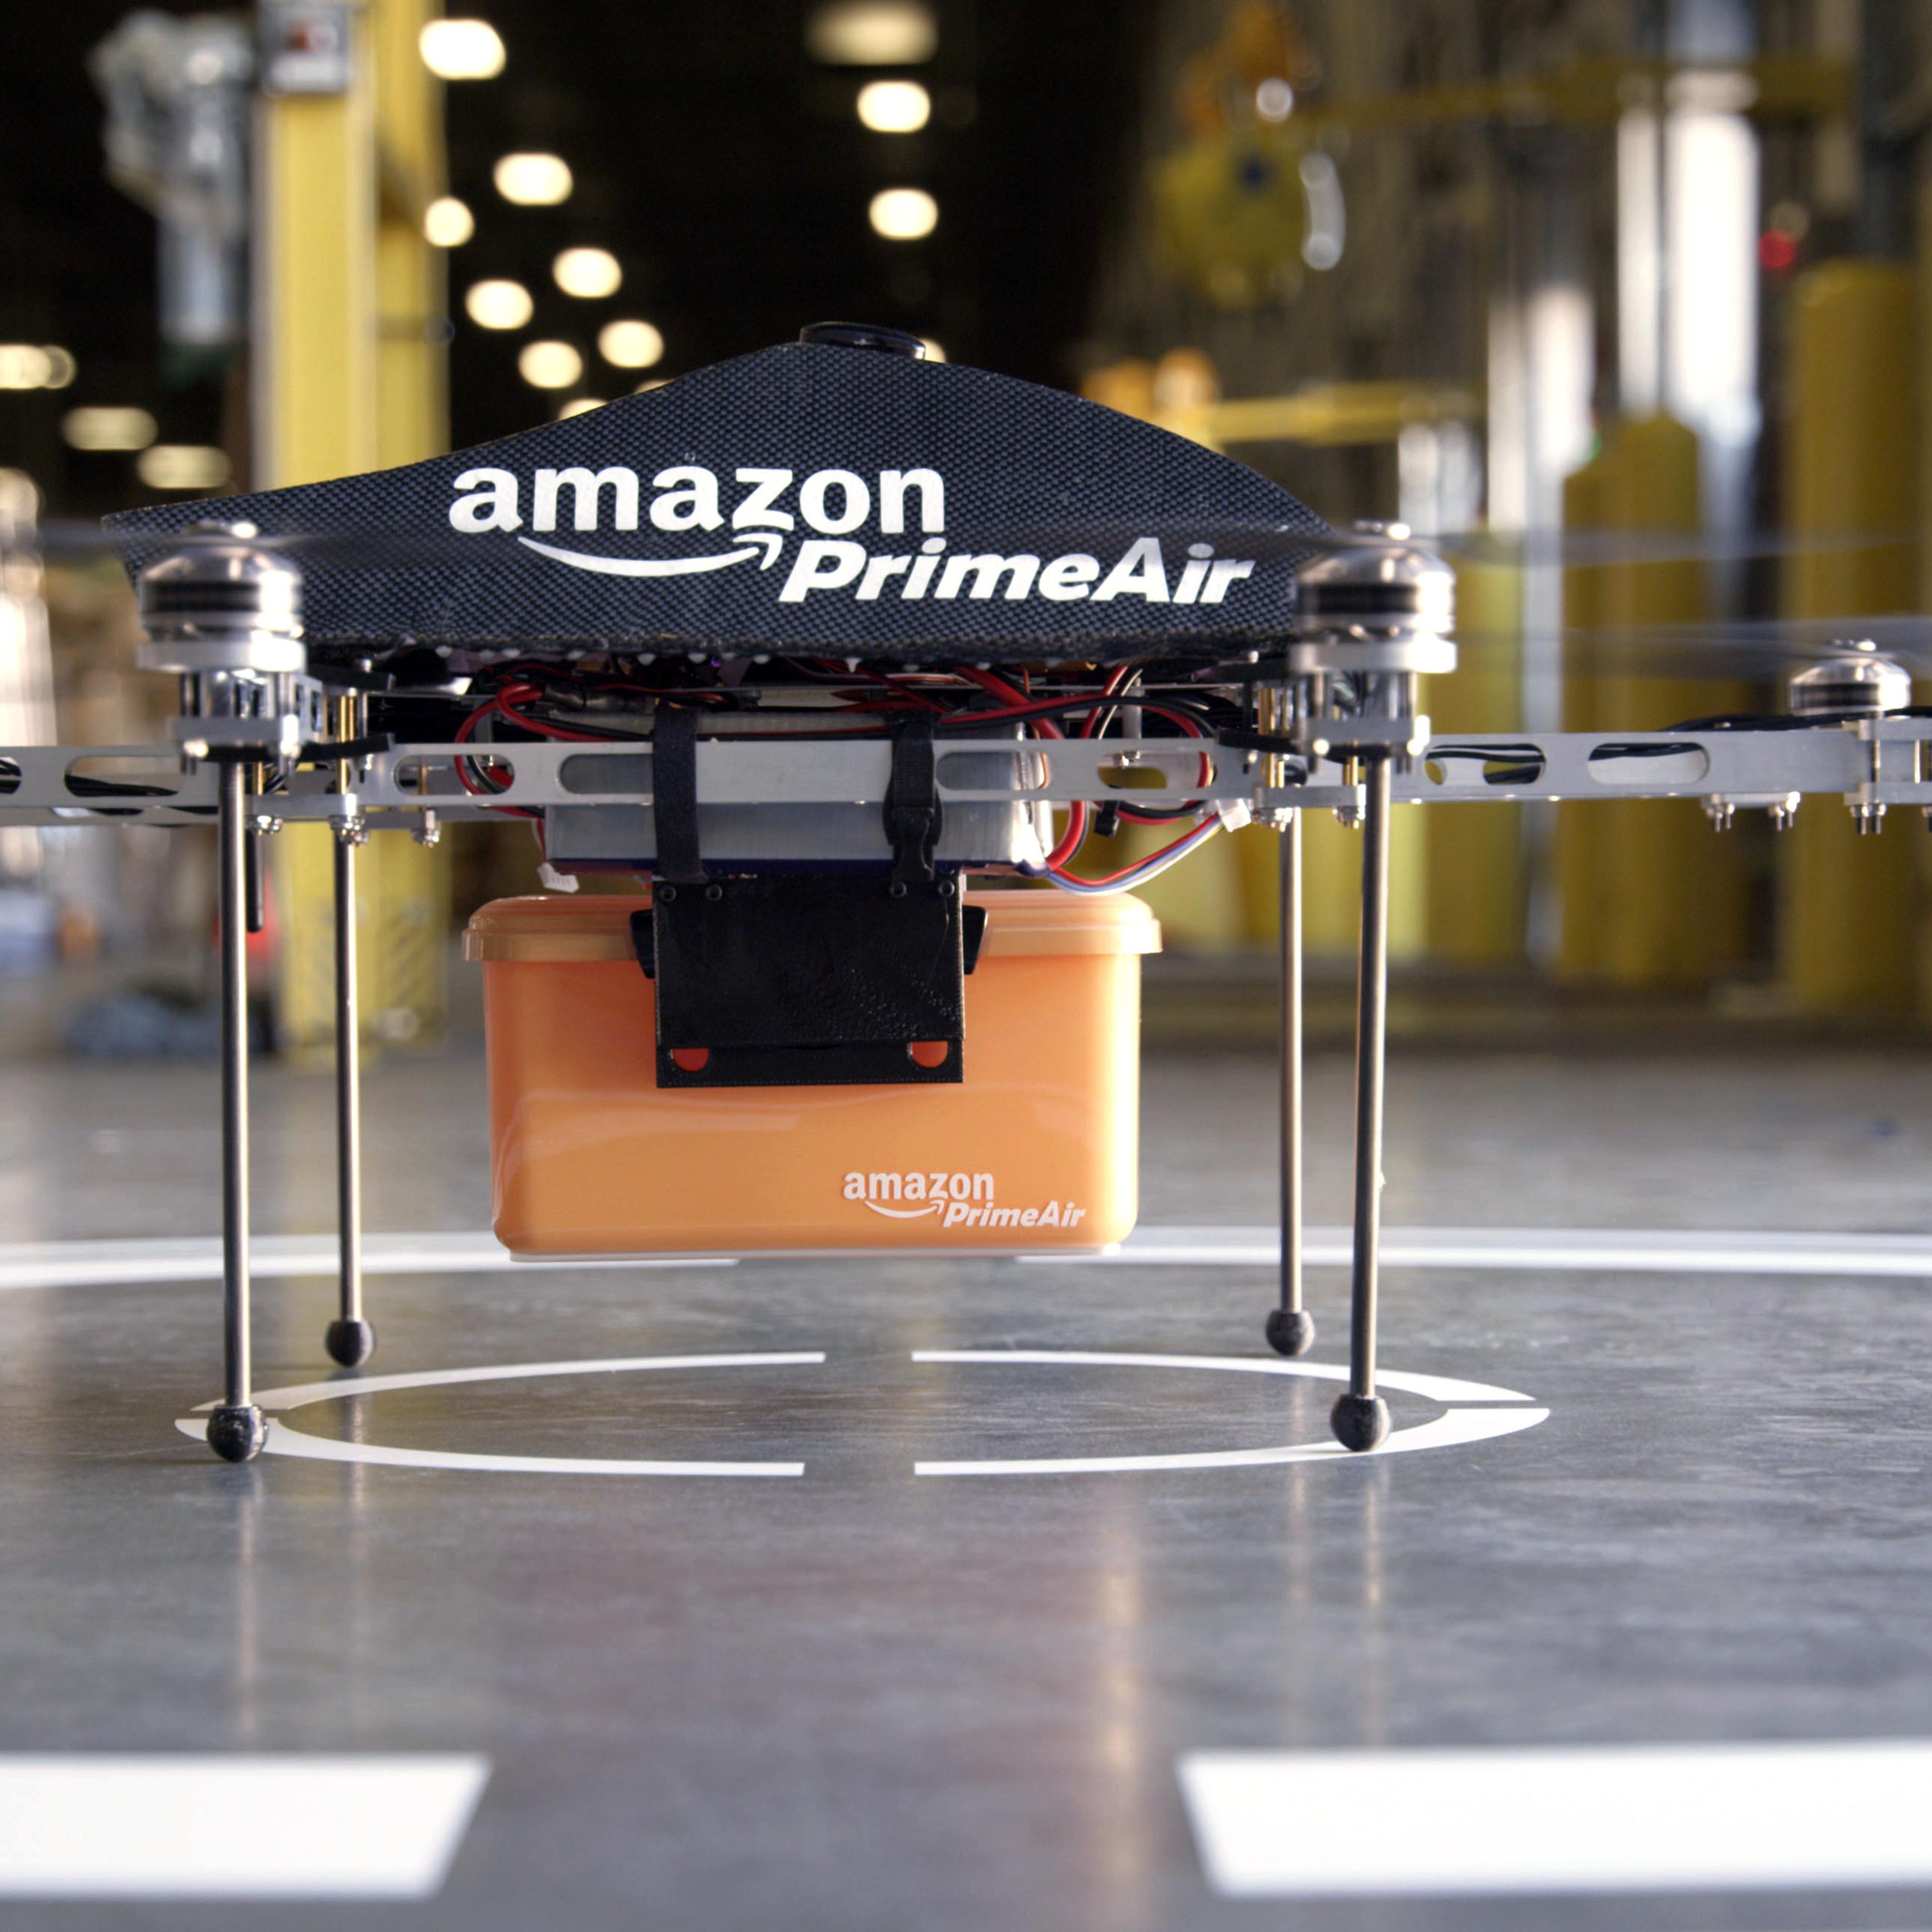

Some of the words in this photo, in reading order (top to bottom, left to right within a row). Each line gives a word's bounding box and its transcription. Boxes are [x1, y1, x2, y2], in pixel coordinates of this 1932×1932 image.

[449, 465, 945, 534] amazon
[778, 536, 1254, 605] PrimeAir
[843, 1171, 994, 1200] amazon
[942, 1200, 1086, 1227] PrimeAir
